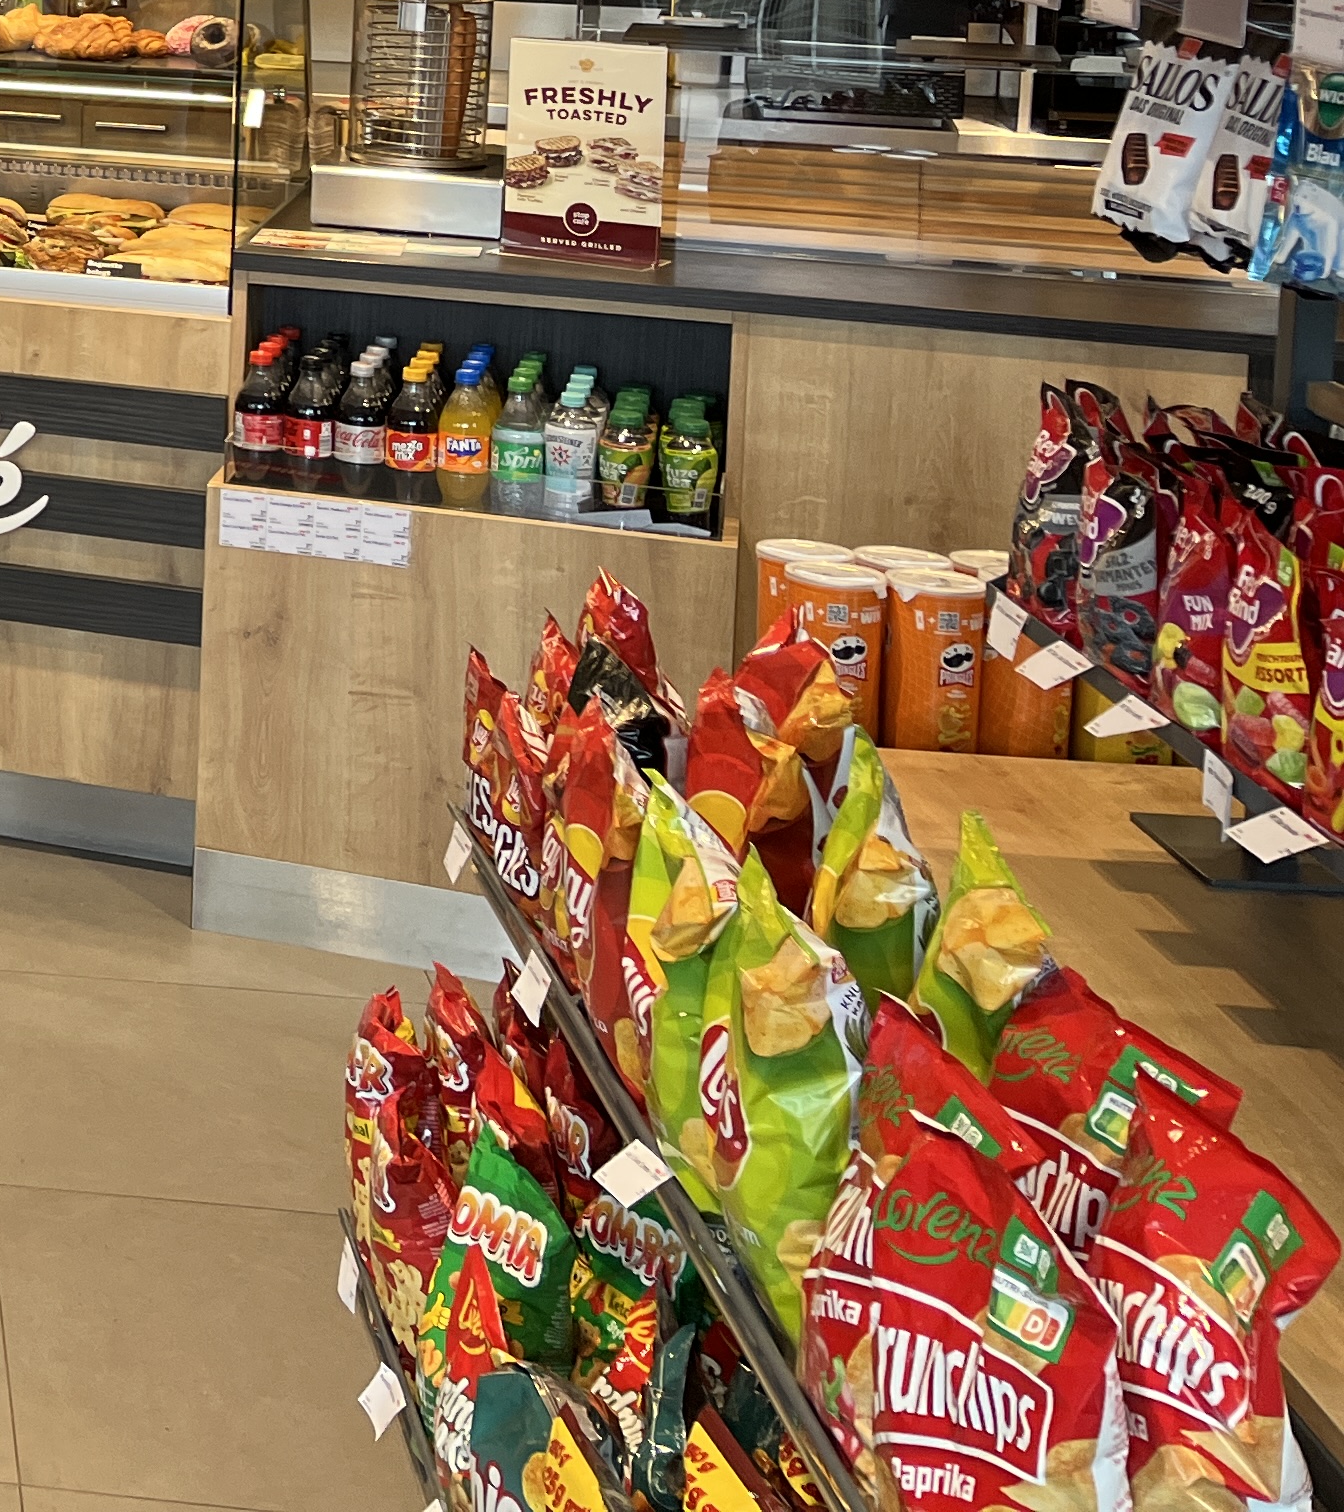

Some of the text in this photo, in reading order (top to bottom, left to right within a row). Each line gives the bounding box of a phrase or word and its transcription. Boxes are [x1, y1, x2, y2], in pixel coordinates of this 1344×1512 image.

[1131, 55, 1220, 112] SALLOS
[524, 86, 654, 115] FRESHLY
[546, 108, 627, 126] TOASTED
[1306, 143, 1341, 167] Blau
[540, 236, 623, 252] SERVED GRILLED
[666, 464, 699, 481] fuze
[666, 476, 692, 489] tea
[1182, 594, 1214, 614] FUN
[1189, 614, 1214, 632] MIX
[874, 1190, 998, 1269] Lorenz
[891, 1455, 976, 1503] Paprika
